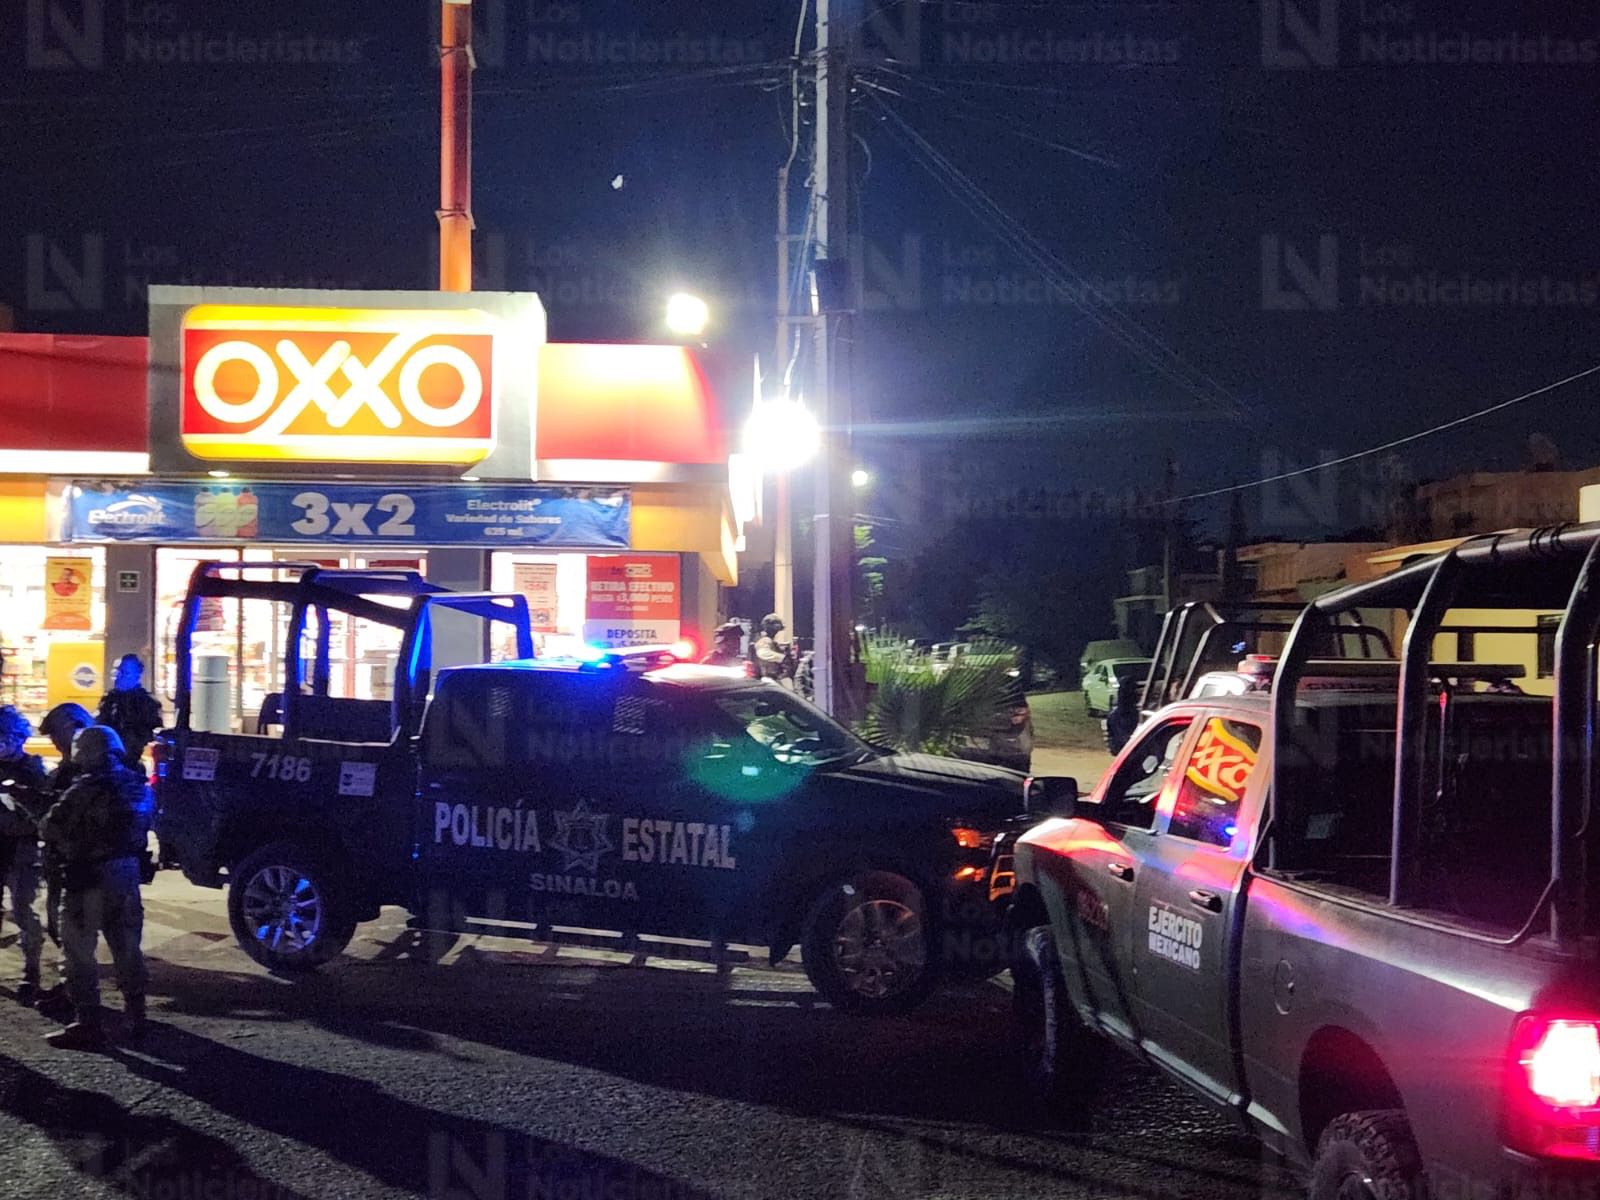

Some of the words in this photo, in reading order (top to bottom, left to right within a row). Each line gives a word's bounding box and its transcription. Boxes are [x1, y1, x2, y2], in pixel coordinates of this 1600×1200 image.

[193, 330, 483, 437] OXXO
[290, 492, 416, 537] 3x2
[499, 514, 513, 523] de
[606, 628, 657, 639] DEPOSITA
[250, 752, 312, 782] 7186
[434, 798, 541, 853] POLICÍA
[622, 817, 737, 870] ESTATAL
[528, 873, 639, 902] SINALOA
[1148, 904, 1203, 949] EJÉRCITO
[1148, 931, 1201, 970] MEXICANO
